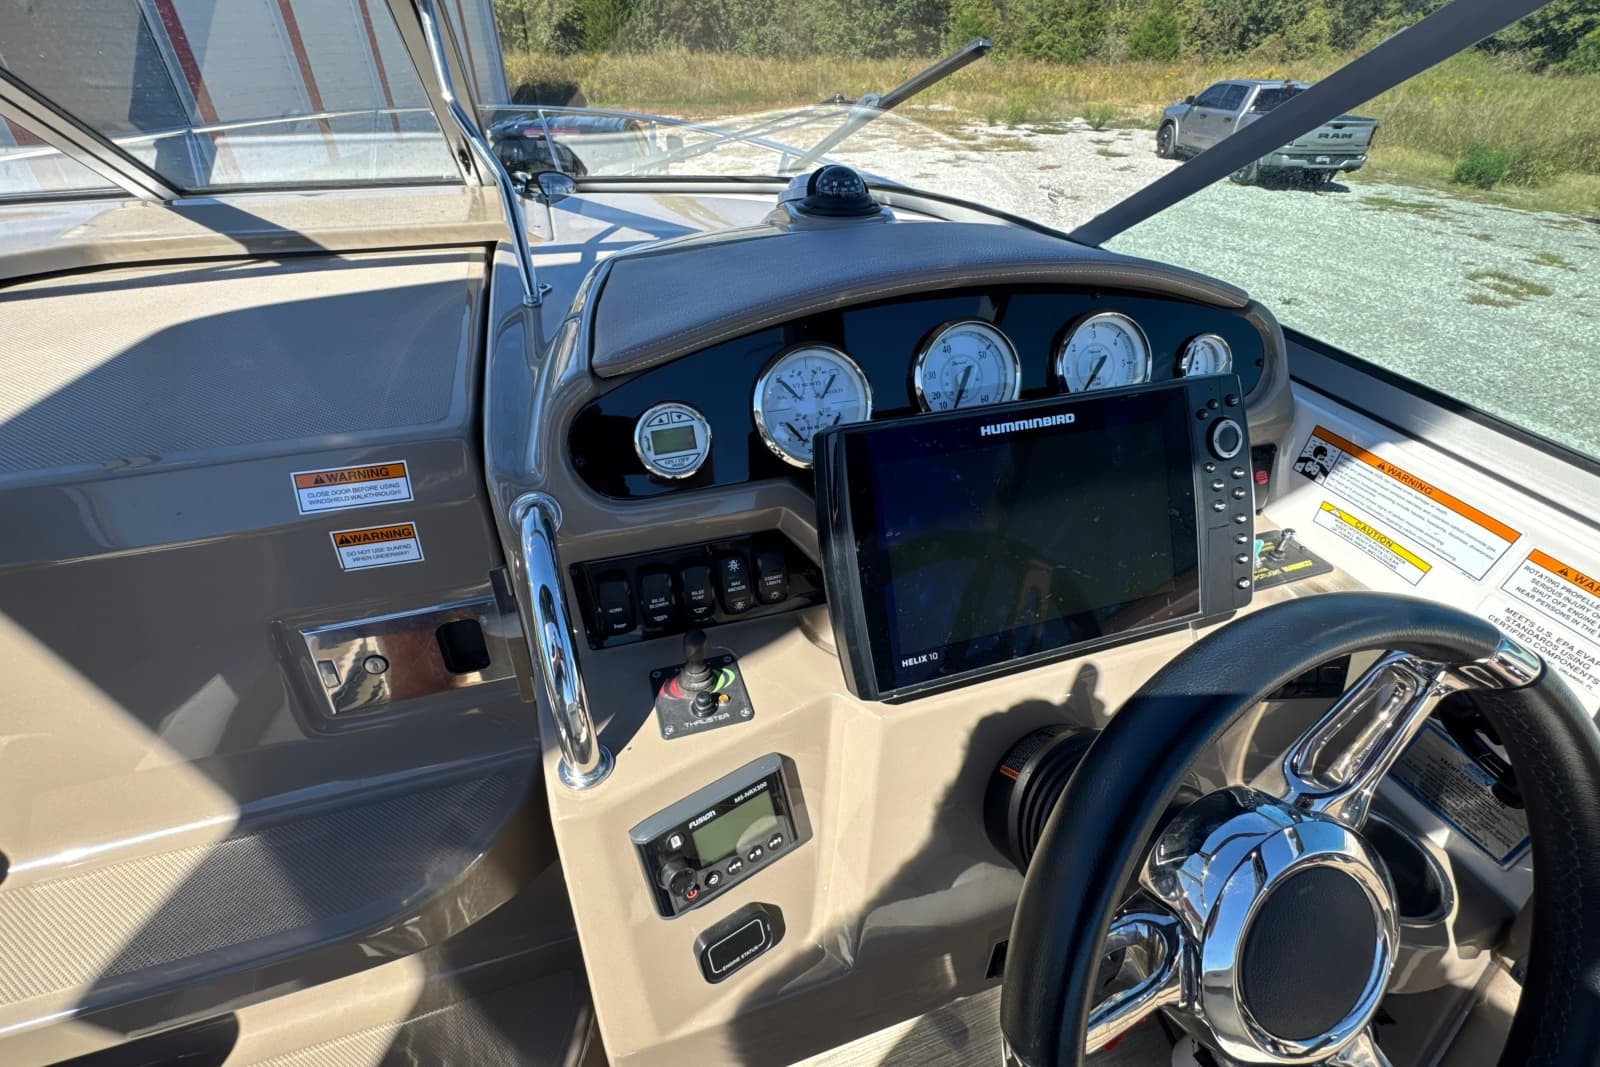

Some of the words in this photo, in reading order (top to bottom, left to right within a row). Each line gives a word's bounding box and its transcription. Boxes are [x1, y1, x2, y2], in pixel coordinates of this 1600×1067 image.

[1090, 330, 1096, 339] 3
[942, 344, 952, 354] 40
[978, 351, 987, 360] 50
[1121, 359, 1126, 368] 5
[928, 371, 936, 380] 30
[932, 392, 941, 400] 20
[940, 401, 948, 410] 10
[980, 412, 1076, 436] HUMMINBIRD
[326, 467, 390, 483] WARNING
[1387, 465, 1433, 495] WARNING
[307, 490, 330, 498] CLOSE
[331, 488, 351, 496] DOOR
[352, 484, 378, 493] BEFORE
[308, 496, 350, 505] WINDSHIELD
[350, 527, 412, 544] WARNING
[1354, 521, 1394, 548] CAUTION
[1524, 565, 1560, 588] ROTATING
[1530, 577, 1564, 598] SERIOUS
[1563, 596, 1592, 614] INJURY
[1592, 612, 1600, 620] O
[1531, 586, 1552, 600] SHUT
[1552, 598, 1568, 608] OFF
[1568, 607, 1598, 626] ENGINE
[1515, 586, 1536, 600] NEAR
[1536, 598, 1572, 620] PERSONS
[1571, 618, 1580, 626] IN
[1580, 623, 1598, 635] THE
[1505, 608, 1536, 628] MEETS
[1536, 626, 1553, 640] U.S.
[1555, 637, 1575, 652] EPA
[1488, 614, 1533, 644] CERTIFIED
[1534, 642, 1600, 685] COMPONENTS
[1504, 616, 1559, 651] STANDARDS
[1560, 649, 1592, 670] USING
[902, 654, 928, 668] HELIX
[928, 652, 938, 660] 10
[684, 712, 730, 728] THRUSTER
[688, 810, 716, 830] FUSION
